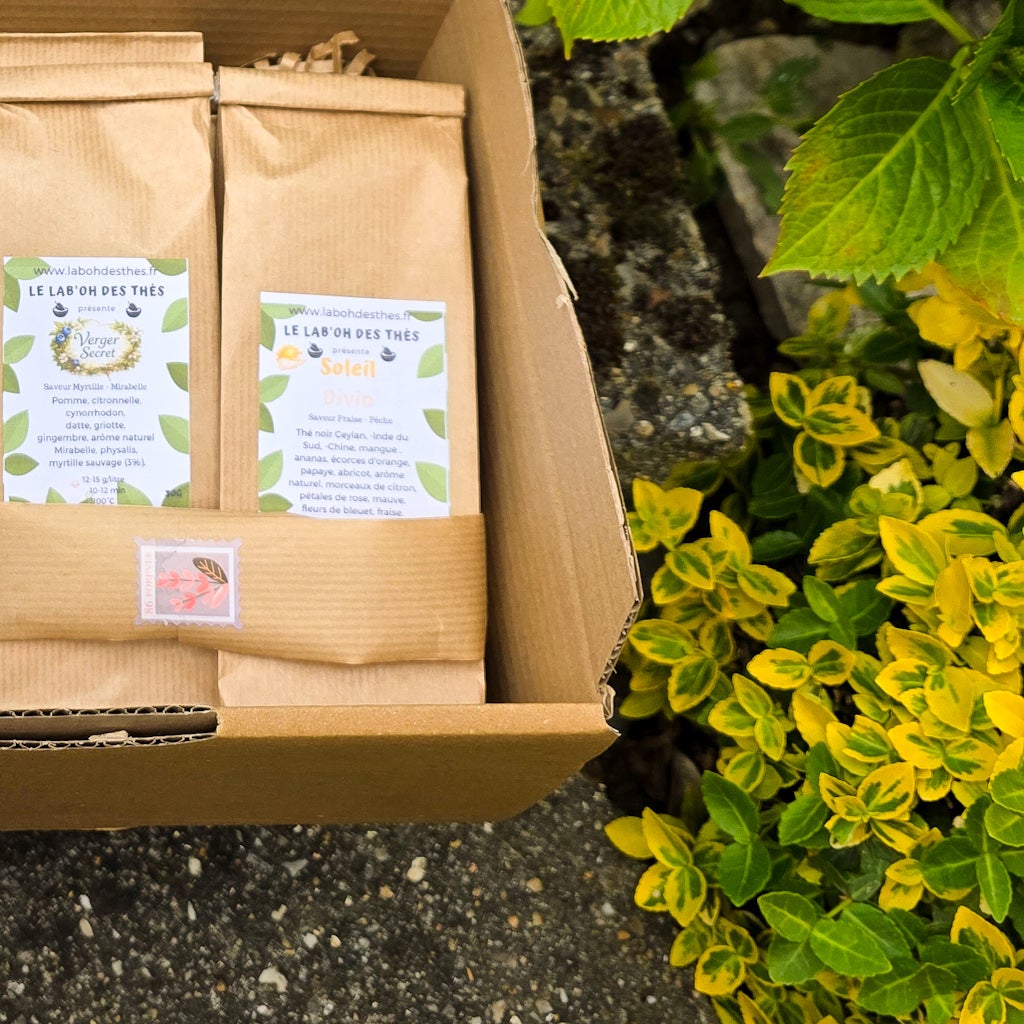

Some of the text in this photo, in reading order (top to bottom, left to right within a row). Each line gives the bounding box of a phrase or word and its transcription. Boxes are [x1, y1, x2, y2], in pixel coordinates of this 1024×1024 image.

[34, 265, 157, 276] www.labohdesthes.fr
[29, 285, 43, 297] LE
[49, 285, 97, 297] LAB'OH
[102, 285, 126, 297] DES
[78, 304, 116, 313] présente
[289, 306, 411, 321] www.labohdesthes.fr
[284, 325, 299, 336] LE
[304, 326, 352, 339] LAB'OH
[356, 329, 381, 340] DES
[73, 331, 120, 349] Verger
[80, 346, 116, 359] Secret
[332, 347, 370, 356] présente
[320, 357, 376, 378] Soleil
[43, 383, 71, 391] Saveur
[72, 383, 104, 392] Myrtille
[111, 383, 148, 391] Mirabelle
[52, 396, 142, 405] Pomme, citronnelle,
[323, 389, 374, 407] Divin
[65, 409, 126, 418] cynorrhodon,
[308, 413, 336, 422] Saveur
[65, 421, 126, 431] datte, griotte,
[37, 433, 155, 443] gingembre, arôme naturel
[296, 428, 312, 437] Thé
[315, 429, 333, 438] noir
[335, 431, 367, 441] Ceylan,
[396, 433, 408, 441] du
[54, 446, 138, 455] Mirabelle, physalis,
[303, 442, 322, 450] Sud,
[49, 458, 84, 468] myrtille
[85, 460, 122, 468] sauvage
[294, 455, 410, 467] ananas, écorces d'orange,
[300, 467, 404, 479] papaye, abricot, arôme
[288, 479, 417, 492] naturel, morceaux de citron,
[299, 492, 406, 504] pétales de rose, mauve,
[302, 504, 327, 513] fleurs
[329, 505, 341, 513] de
[343, 506, 375, 516] bleuet,
